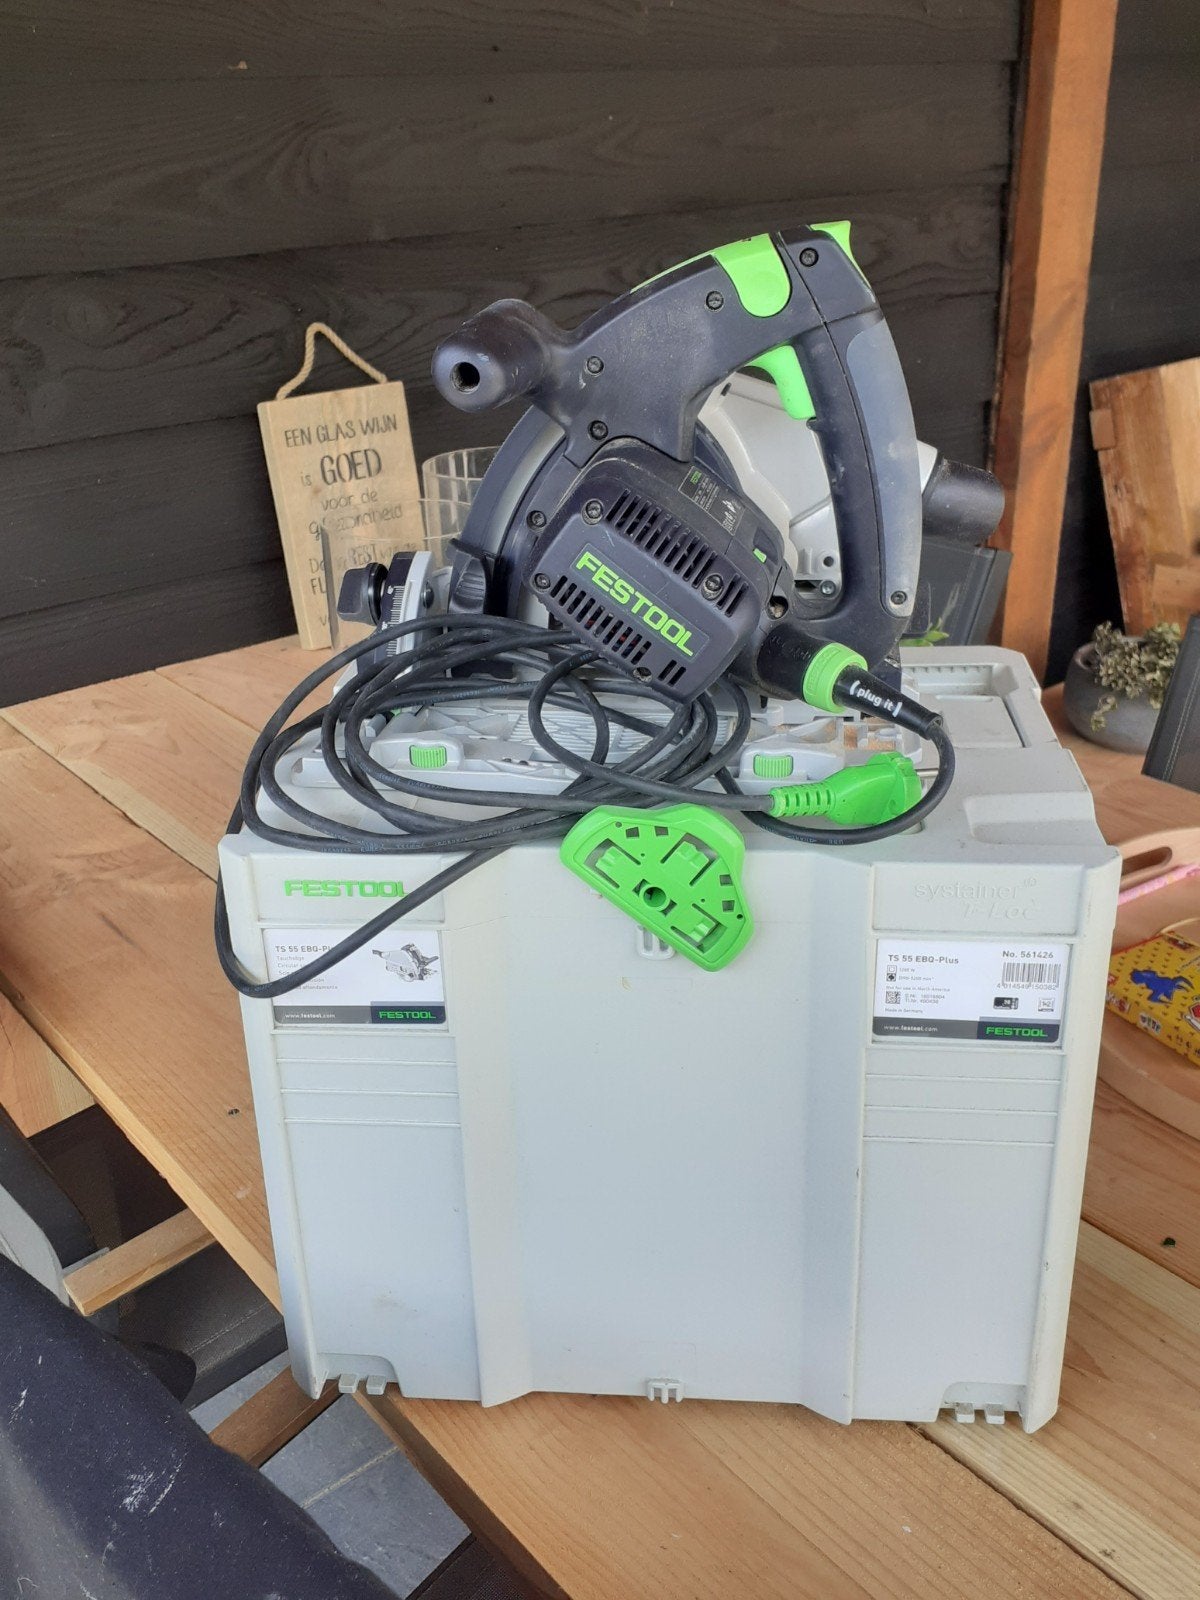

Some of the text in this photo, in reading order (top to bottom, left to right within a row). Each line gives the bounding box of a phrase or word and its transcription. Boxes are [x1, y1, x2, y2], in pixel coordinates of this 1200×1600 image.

[284, 414, 397, 448] EEN GLAS WIJN
[300, 448, 382, 486] is GOED
[321, 488, 378, 511] voor de
[575, 551, 694, 656] FESTOOL
[914, 881, 1018, 903] systainer
[300, 945, 331, 953] EBQ-Pl
[1002, 950, 1054, 959] No. 561426
[888, 954, 959, 964] TS 55 EBQ-Plus
[378, 1010, 437, 1019] FESTOOL
[883, 1024, 1049, 1038] www.festool.com FESTOOL
